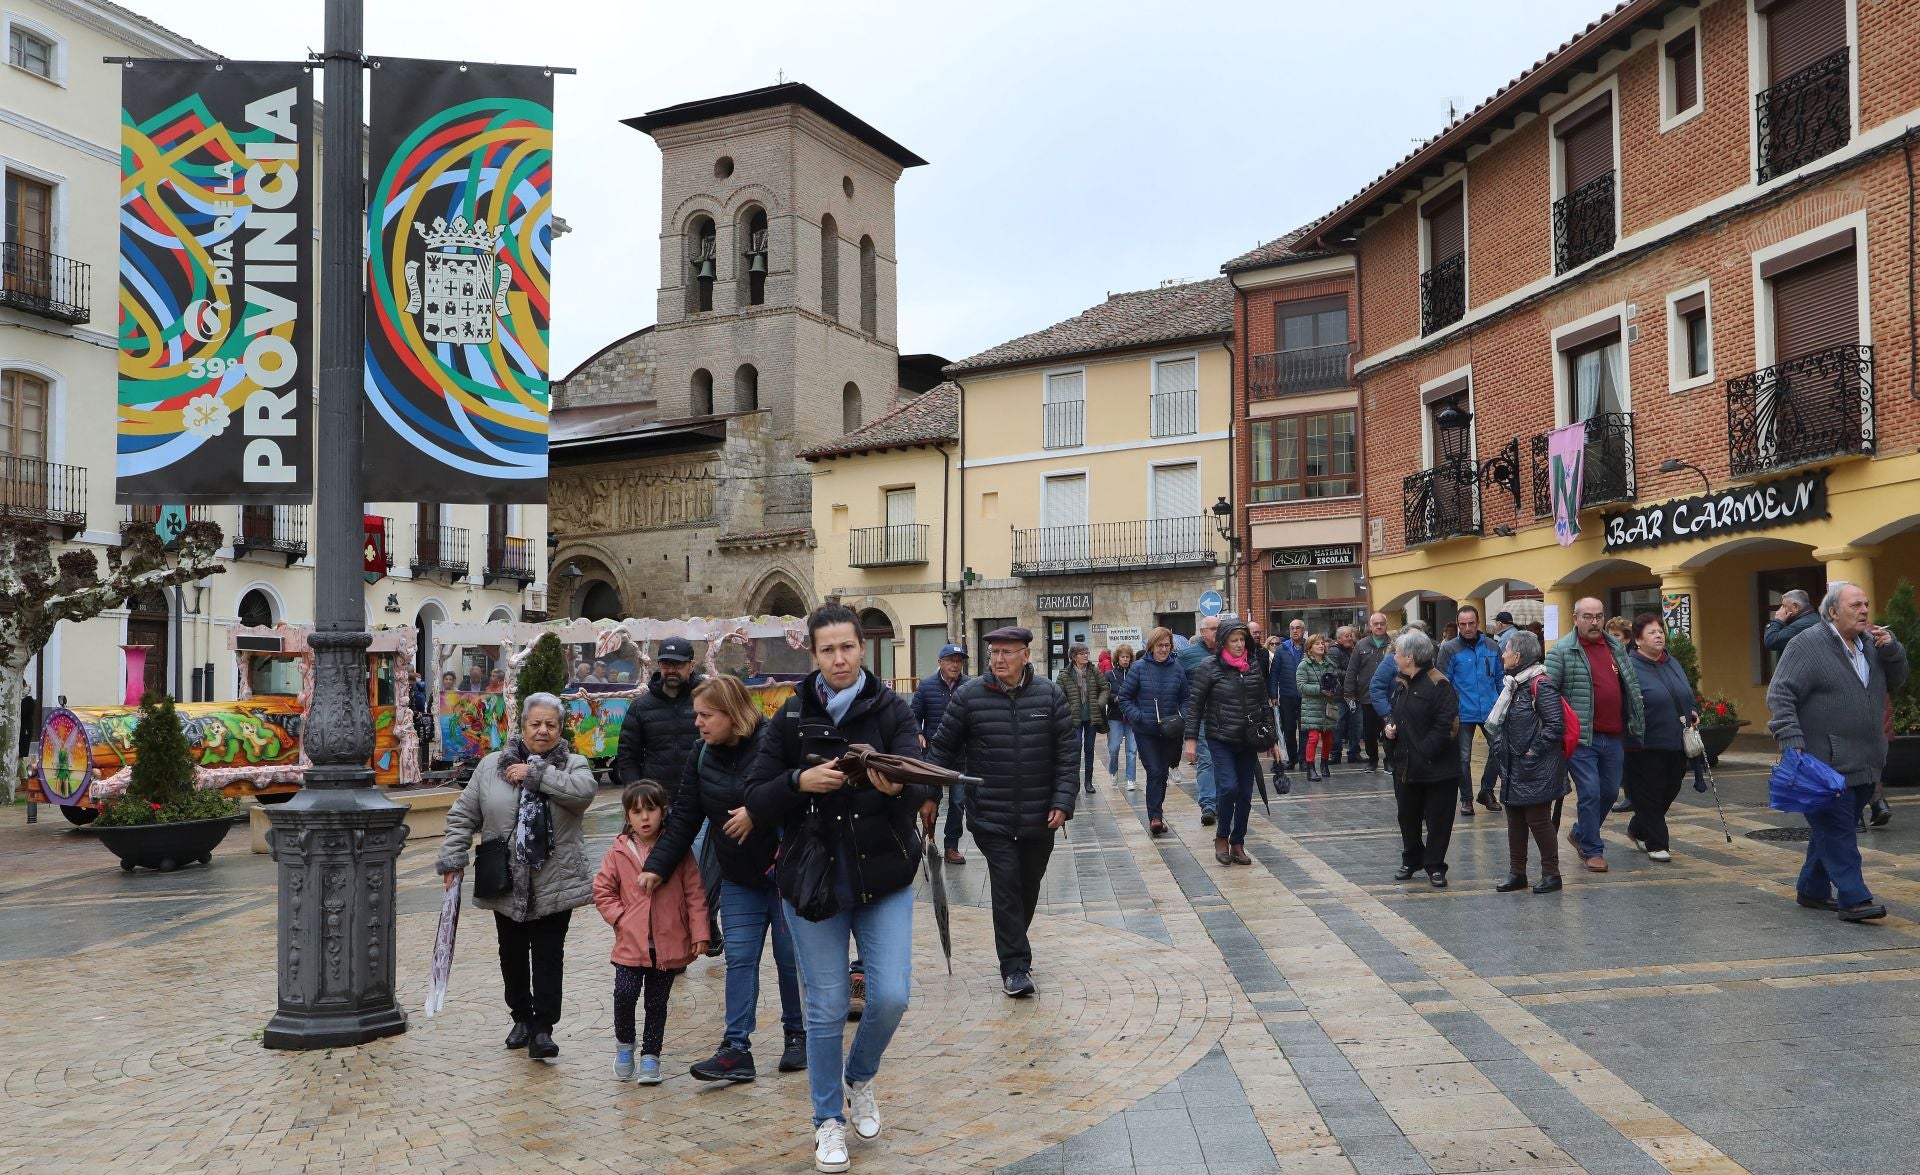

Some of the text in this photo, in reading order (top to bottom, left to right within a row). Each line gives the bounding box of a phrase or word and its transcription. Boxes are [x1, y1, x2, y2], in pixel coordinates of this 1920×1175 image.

[213, 160, 234, 194] LA
[213, 200, 234, 233] DE
[242, 86, 298, 483] PROVINCIA
[1607, 479, 1815, 546] BAR CARMEN
[1275, 552, 1309, 565] ASUN
[1314, 547, 1352, 557] MATERIAL
[1316, 556, 1350, 565] ESCOLAR
[1039, 595, 1090, 609] FARMACIA
